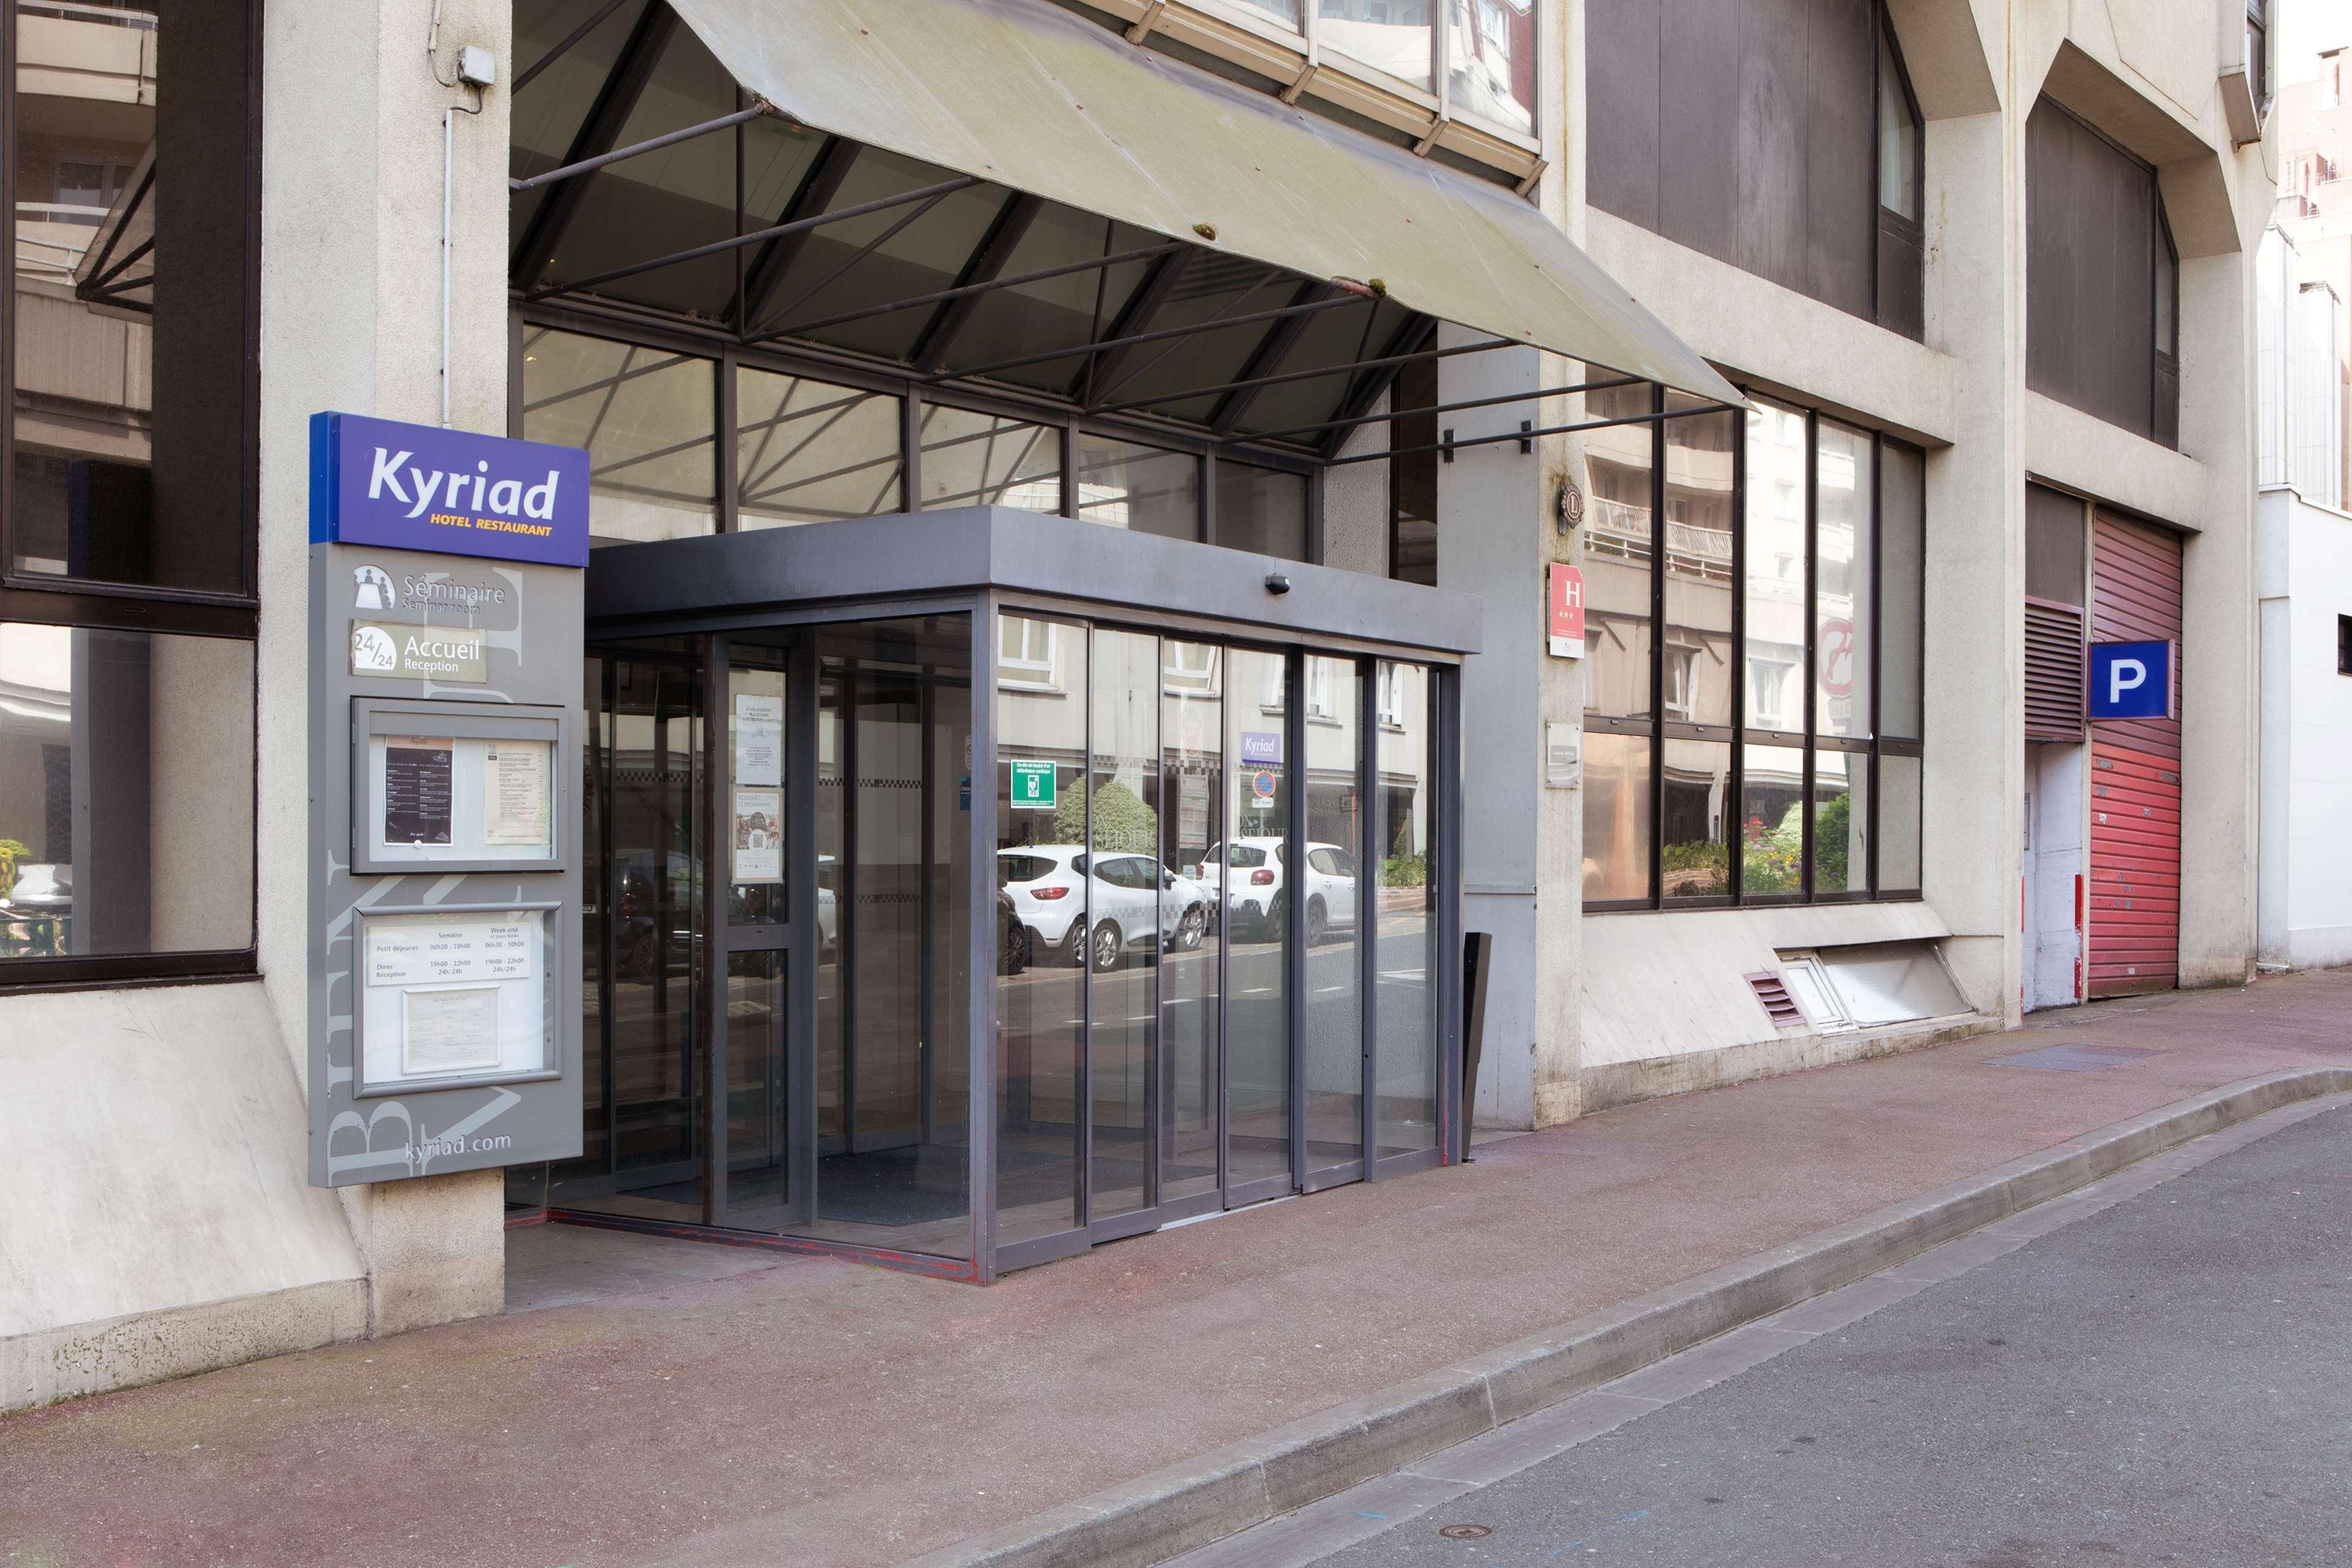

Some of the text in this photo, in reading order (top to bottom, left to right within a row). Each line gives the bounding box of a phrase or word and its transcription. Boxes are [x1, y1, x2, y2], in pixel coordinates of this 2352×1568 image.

[368, 447, 561, 520] Kyriad
[1570, 495, 1578, 513] L
[430, 514, 553, 537] HOTEL RESTAURANT
[404, 574, 505, 605] Séminaire
[1565, 580, 1581, 608] H
[402, 597, 481, 615] Seminar room
[404, 635, 480, 661] Accueil
[404, 658, 458, 674] Reception
[2109, 658, 2147, 704] P
[1245, 737, 1275, 755] Kyriad
[405, 1133, 512, 1165] kyriad.com
